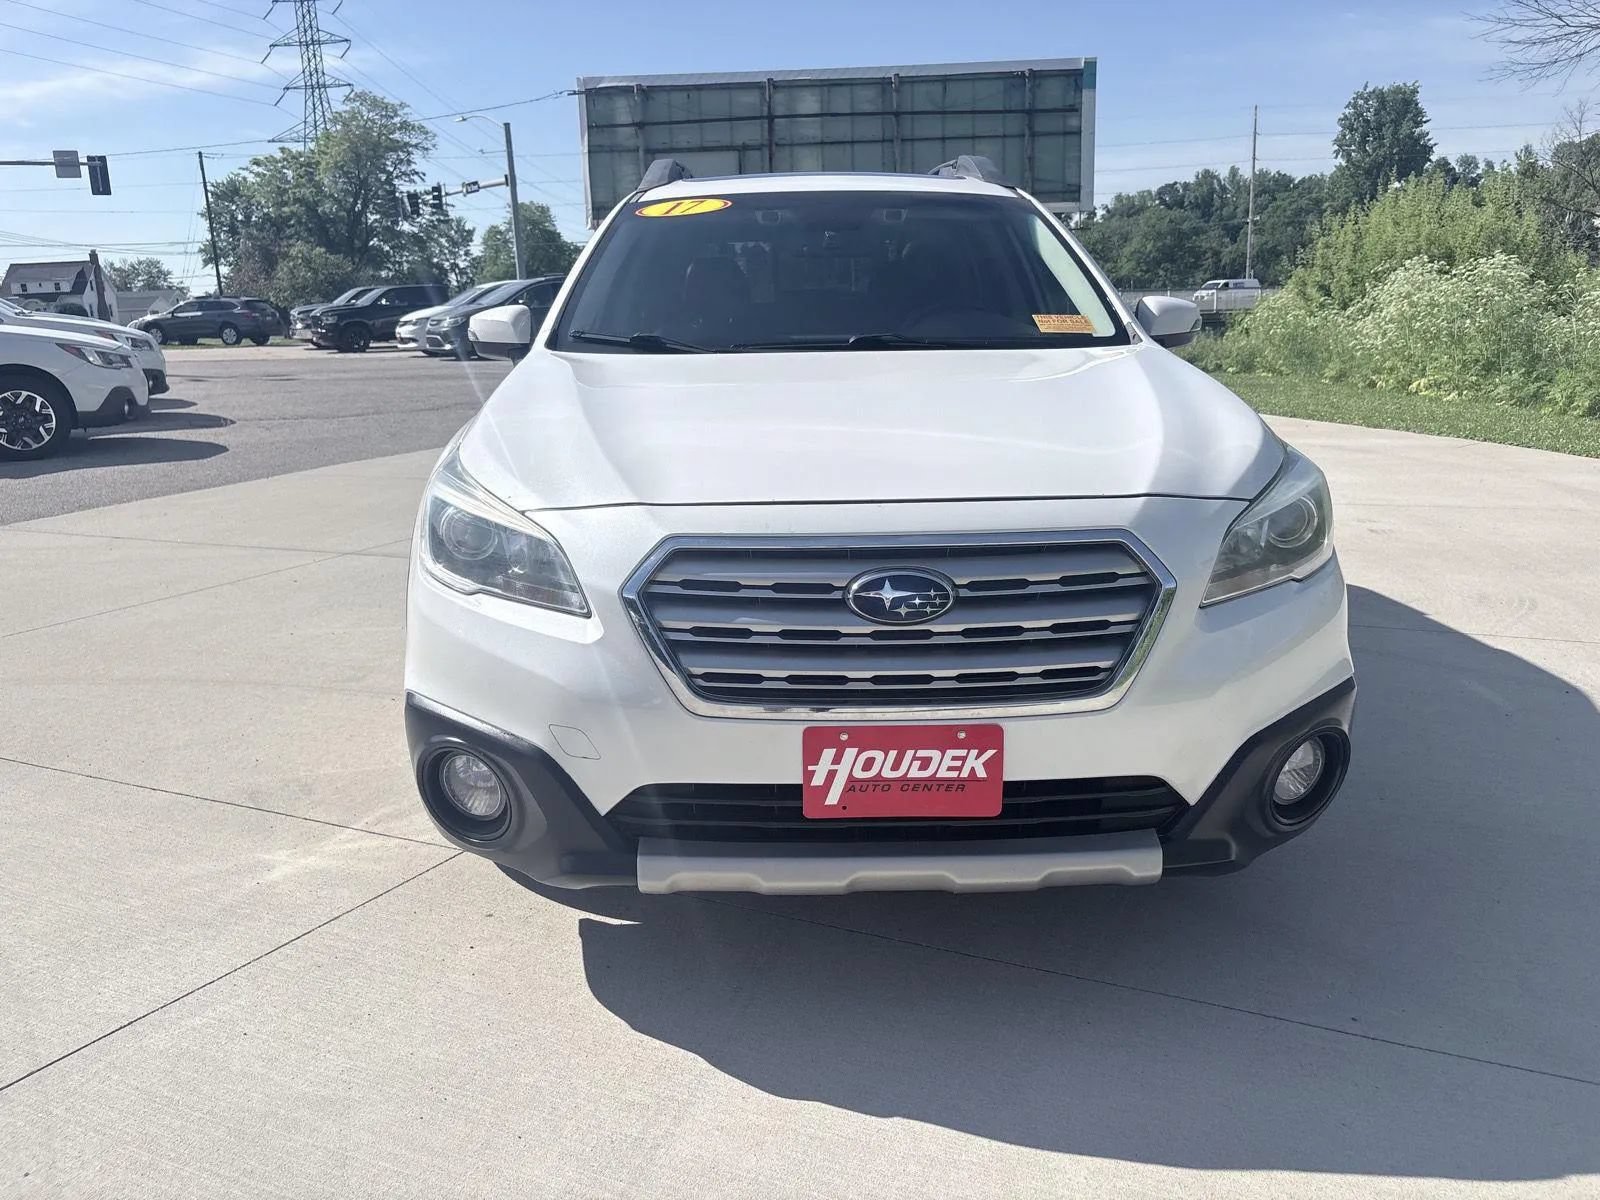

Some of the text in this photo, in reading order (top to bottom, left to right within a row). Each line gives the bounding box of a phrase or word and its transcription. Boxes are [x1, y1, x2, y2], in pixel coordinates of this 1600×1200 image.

[663, 199, 706, 215] 17
[808, 747, 999, 806] HOUDEK
[846, 782, 966, 793] AUTO CENTER
